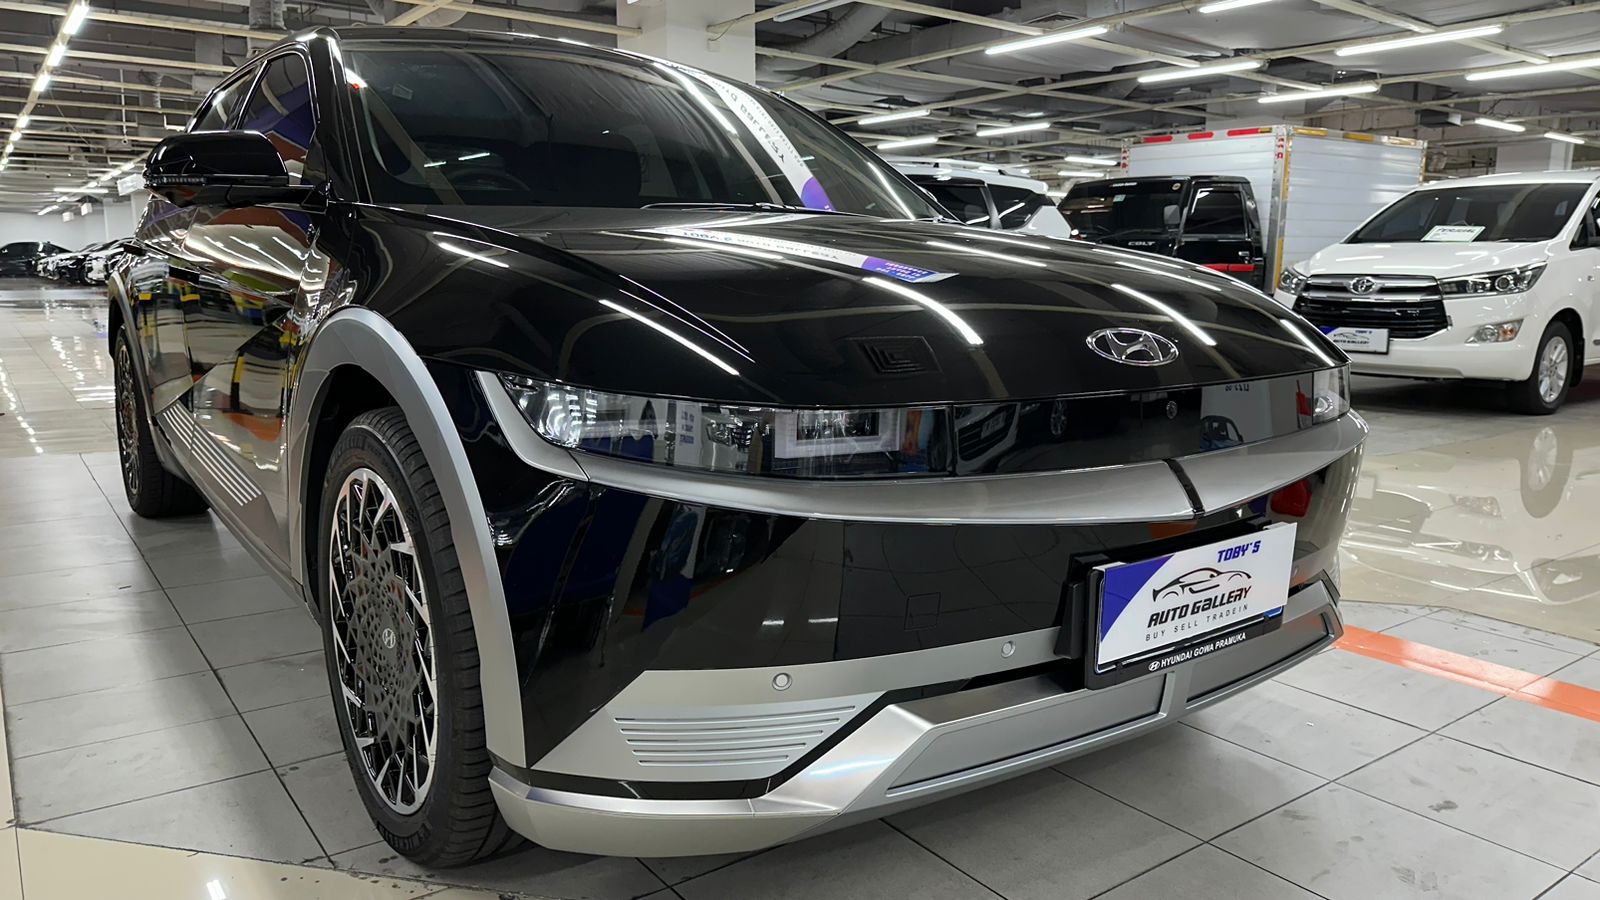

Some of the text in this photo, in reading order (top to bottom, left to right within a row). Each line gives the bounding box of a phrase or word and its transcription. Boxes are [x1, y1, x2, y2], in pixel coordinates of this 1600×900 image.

[1217, 540, 1261, 563] TOBY'S
[1145, 604, 1249, 642] BUY SELL TRADEIN
[1147, 605, 1188, 628] AUTO
[1160, 632, 1247, 668] HYUNDAI GOWA PRAMUKA
